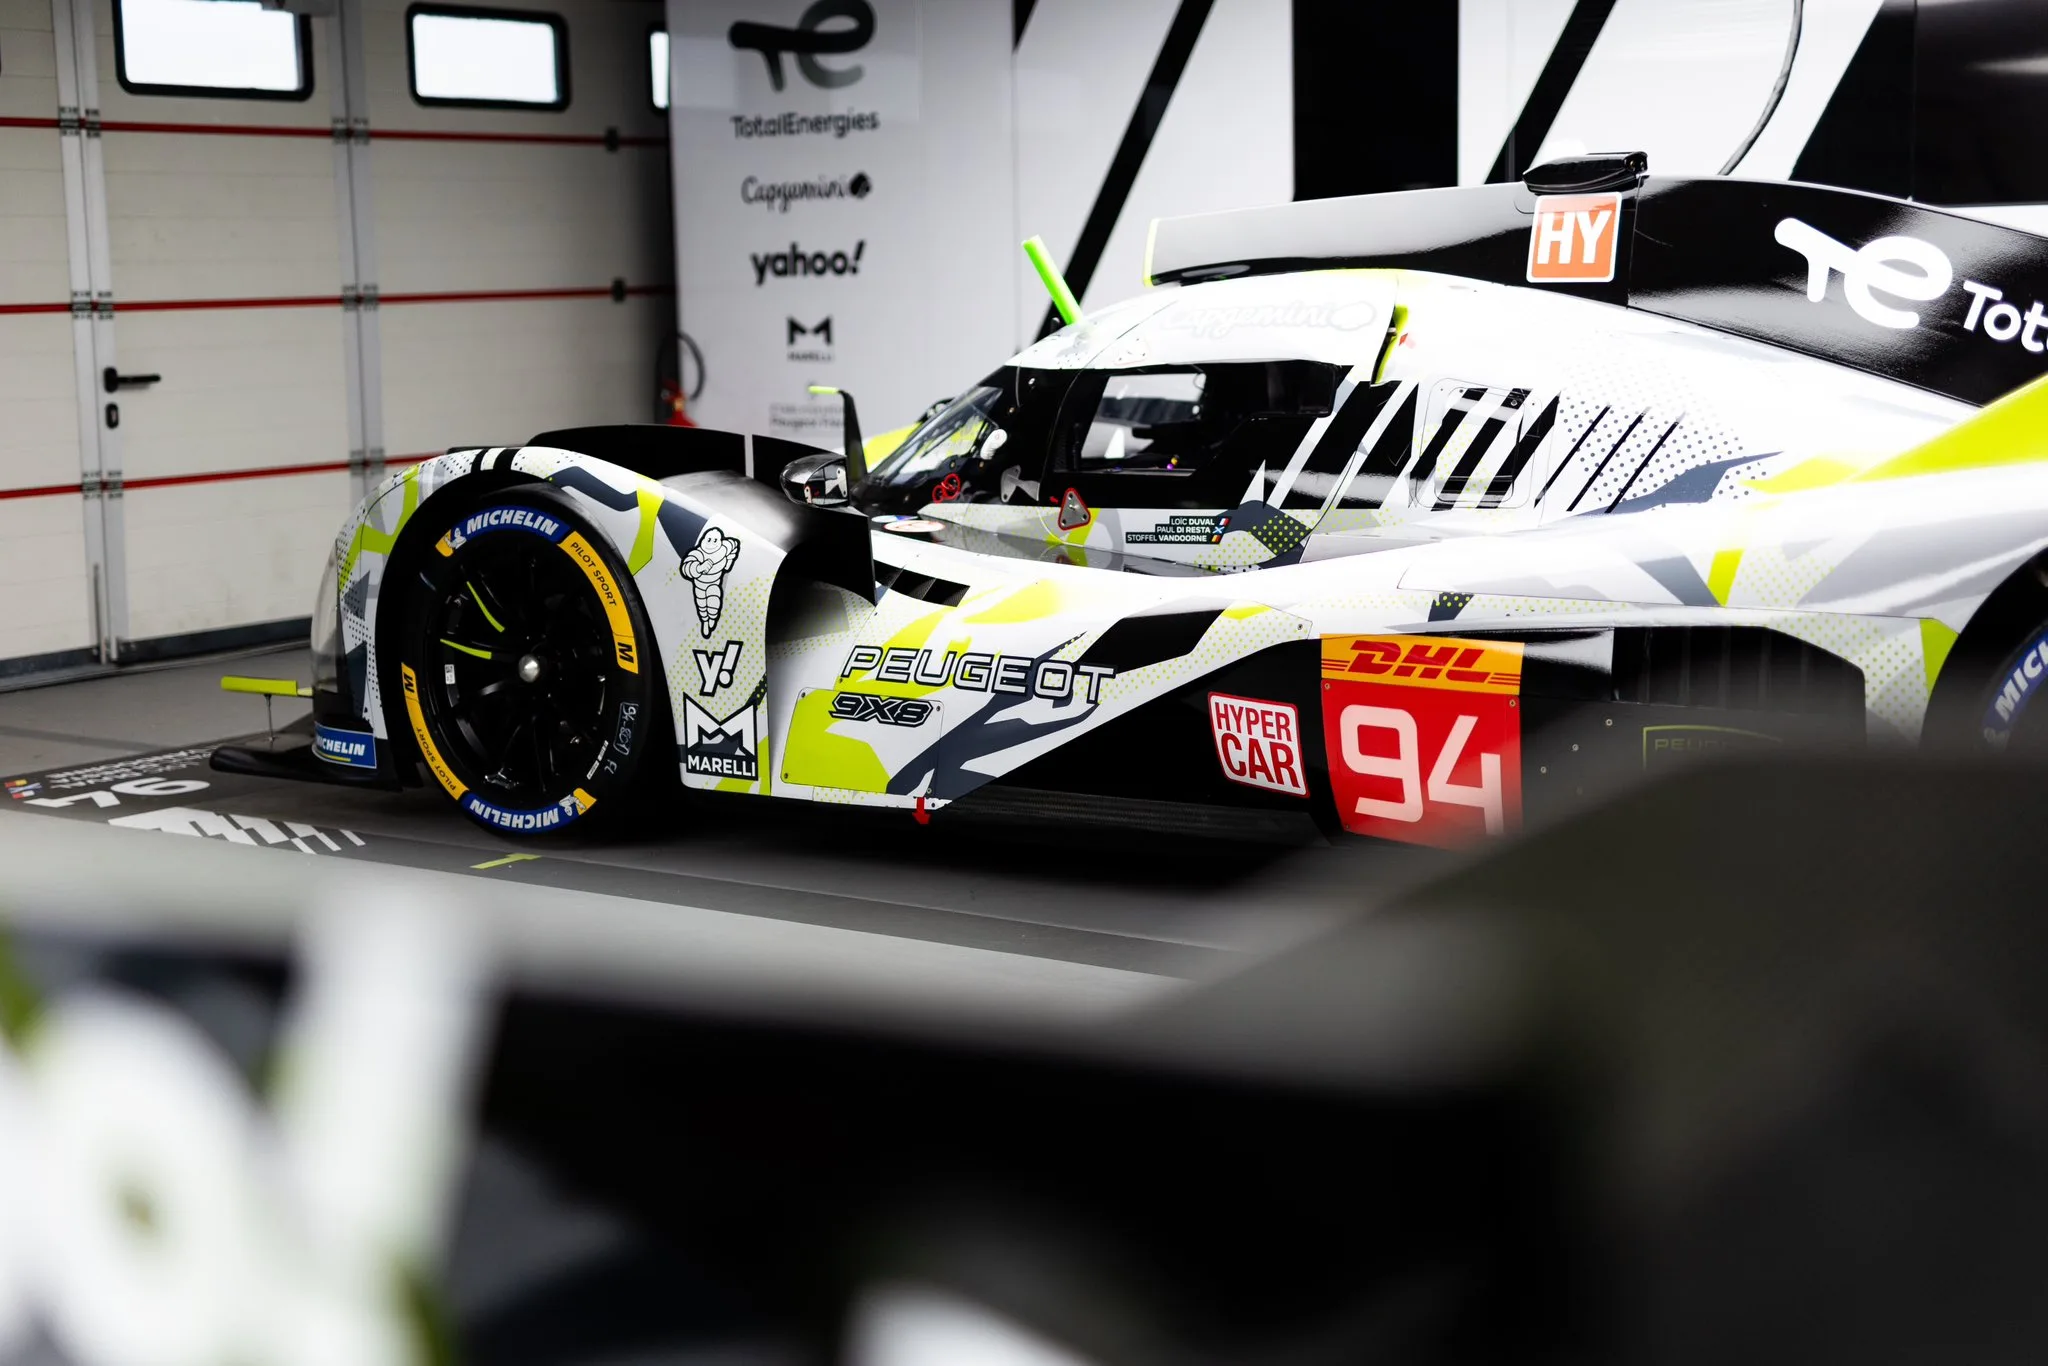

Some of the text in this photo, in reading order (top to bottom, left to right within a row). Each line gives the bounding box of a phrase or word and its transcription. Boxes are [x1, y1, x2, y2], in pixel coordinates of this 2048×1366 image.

[730, 107, 881, 139] TotalEnergies
[740, 174, 848, 214] Capgemini
[1537, 210, 1612, 265] HY
[750, 239, 866, 287] yahoo!
[1962, 279, 2048, 353] Tot
[466, 509, 560, 536] MICHELIN
[1127, 533, 1208, 543] STOFFEL VANDOORNE
[1156, 525, 1212, 534] PAUL DI RESTA
[1188, 517, 1216, 526] DUVAL
[570, 541, 597, 569] PILOT
[593, 569, 618, 608] SPORT
[840, 645, 1117, 705] PEUGEOT
[1347, 640, 1491, 683] DHL
[828, 691, 935, 728] 9X8
[1214, 701, 1292, 742] HYPER
[416, 726, 458, 792] PILOT SPORT
[687, 754, 756, 777] MARELLI
[1221, 732, 1301, 789] CAR
[1340, 704, 1505, 836] 94
[469, 798, 560, 830] MICHELIN
